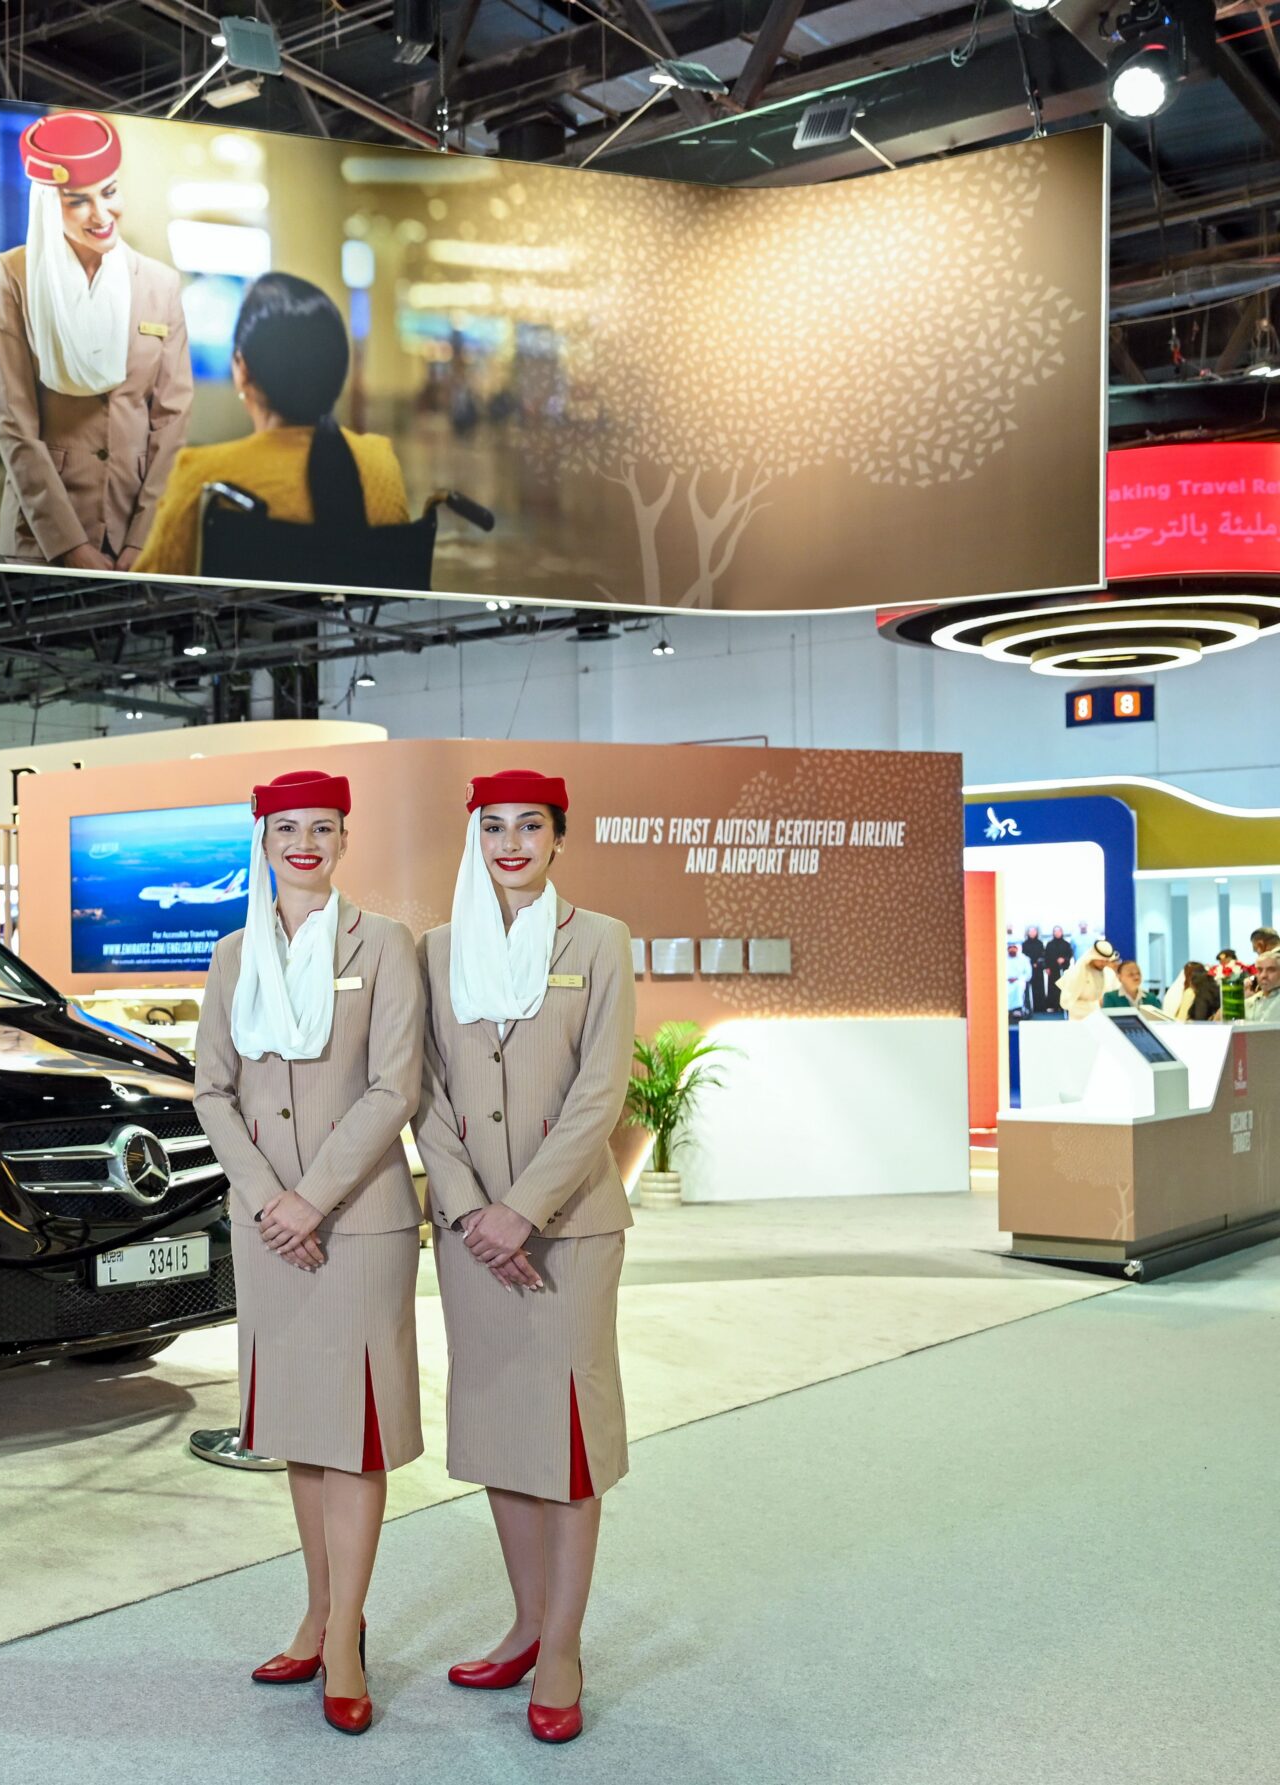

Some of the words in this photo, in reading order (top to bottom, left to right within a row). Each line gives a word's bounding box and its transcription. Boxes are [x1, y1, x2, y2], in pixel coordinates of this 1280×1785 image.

[1107, 482, 1171, 502] aking
[1178, 477, 1246, 496] Travel
[1077, 697, 1089, 718] 8
[1120, 693, 1134, 714] 8
[595, 816, 664, 844] WORLD'S
[667, 817, 711, 845] FIRST
[713, 818, 771, 845] AUTISM
[774, 819, 846, 847] CERTIFIED
[849, 820, 906, 847] AIRLINE
[685, 847, 718, 874] AND
[720, 848, 785, 875] AIRPORT
[788, 848, 820, 875] HUB
[148, 1244, 188, 1275] 33415
[108, 1266, 118, 1283] L
